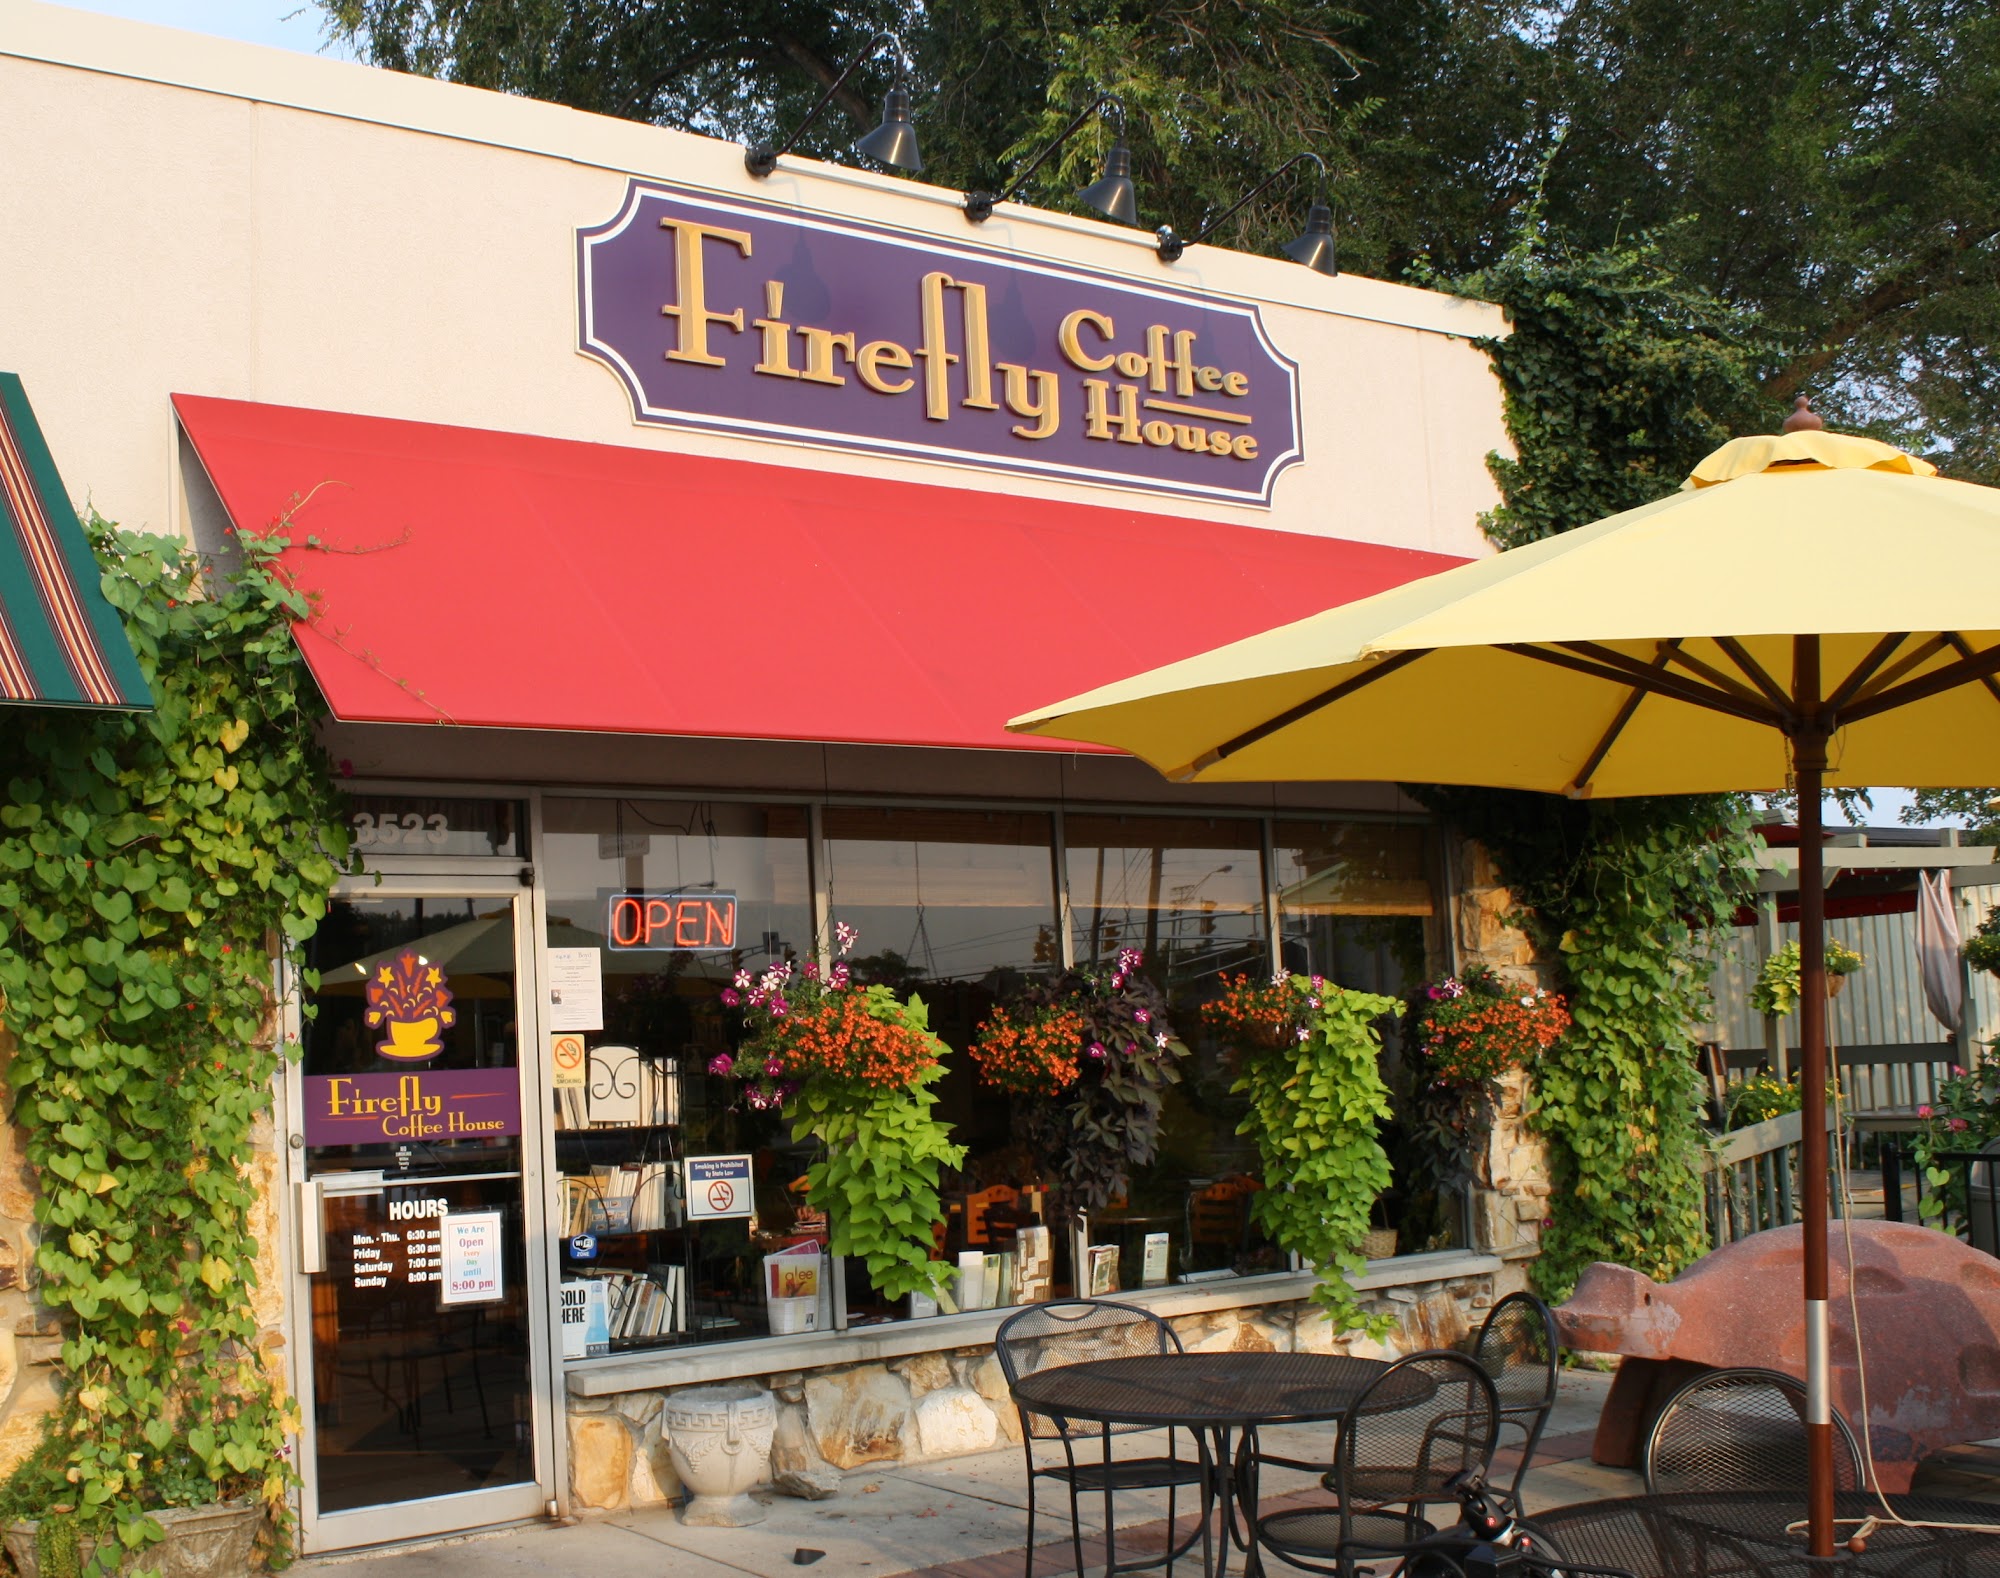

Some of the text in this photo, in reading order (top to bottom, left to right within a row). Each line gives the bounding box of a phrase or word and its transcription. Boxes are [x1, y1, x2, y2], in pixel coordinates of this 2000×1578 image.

[660, 216, 1059, 439] Firefly
[1059, 308, 1249, 397] Coffee
[1085, 378, 1259, 461] House
[352, 812, 449, 845] 3523
[613, 897, 733, 946] OPEN
[327, 1076, 442, 1116] Firefly
[382, 1111, 505, 1137] Coffee House
[389, 1198, 449, 1220] HOURS
[353, 1234, 375, 1245] Mon.
[381, 1232, 400, 1243] Thu.
[407, 1230, 426, 1240] 6:30
[427, 1230, 440, 1239] am
[456, 1226, 469, 1234] We
[459, 1238, 484, 1248] Open
[353, 1244, 441, 1260] Friday 6:30 am
[354, 1258, 441, 1274] Saturday 7:00 am
[463, 1268, 482, 1276] until
[354, 1272, 442, 1288] Sunday 8:00 am
[452, 1280, 493, 1291] 8:00 pm
[560, 1289, 586, 1306] SOLD
